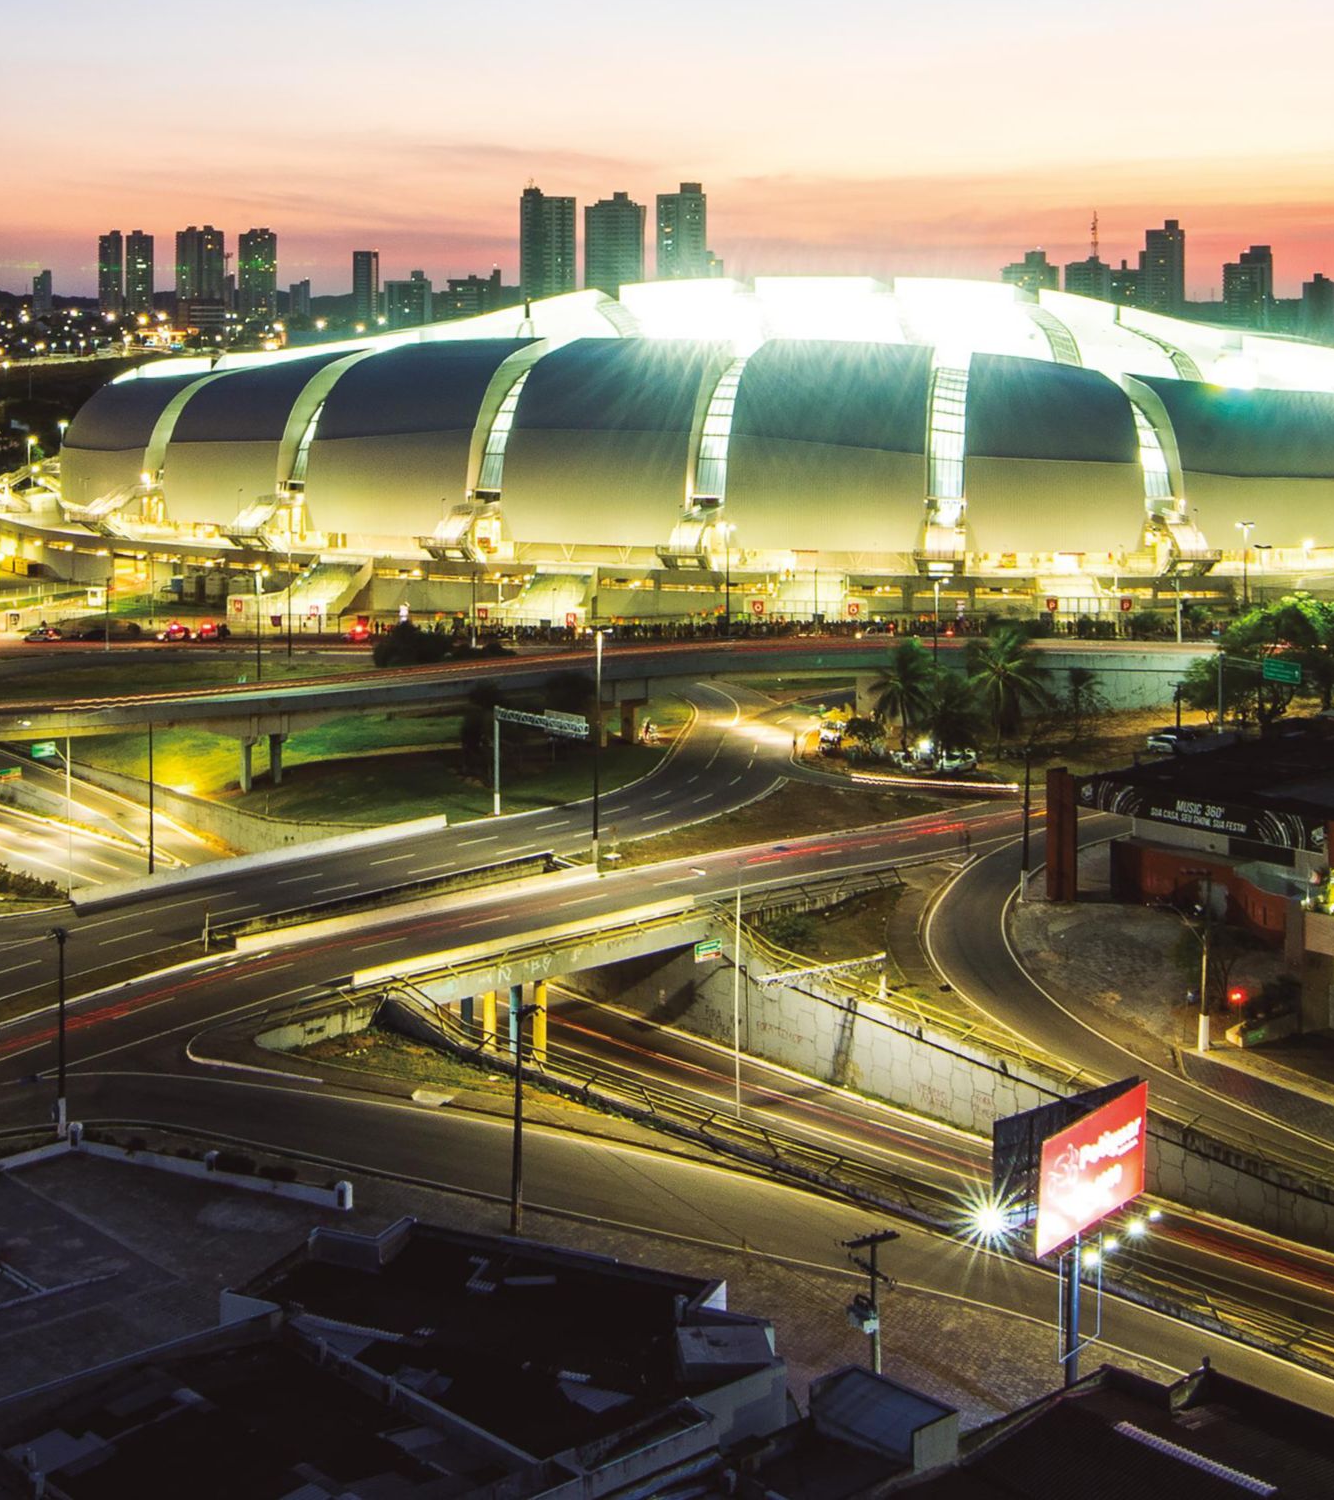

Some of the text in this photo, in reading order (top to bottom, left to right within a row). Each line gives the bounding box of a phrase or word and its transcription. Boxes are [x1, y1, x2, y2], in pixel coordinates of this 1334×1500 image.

[1176, 800, 1202, 815] MUSIC
[1150, 807, 1163, 816] SUA
[1180, 813, 1193, 823] SEU
[1212, 819, 1225, 829] SUA
